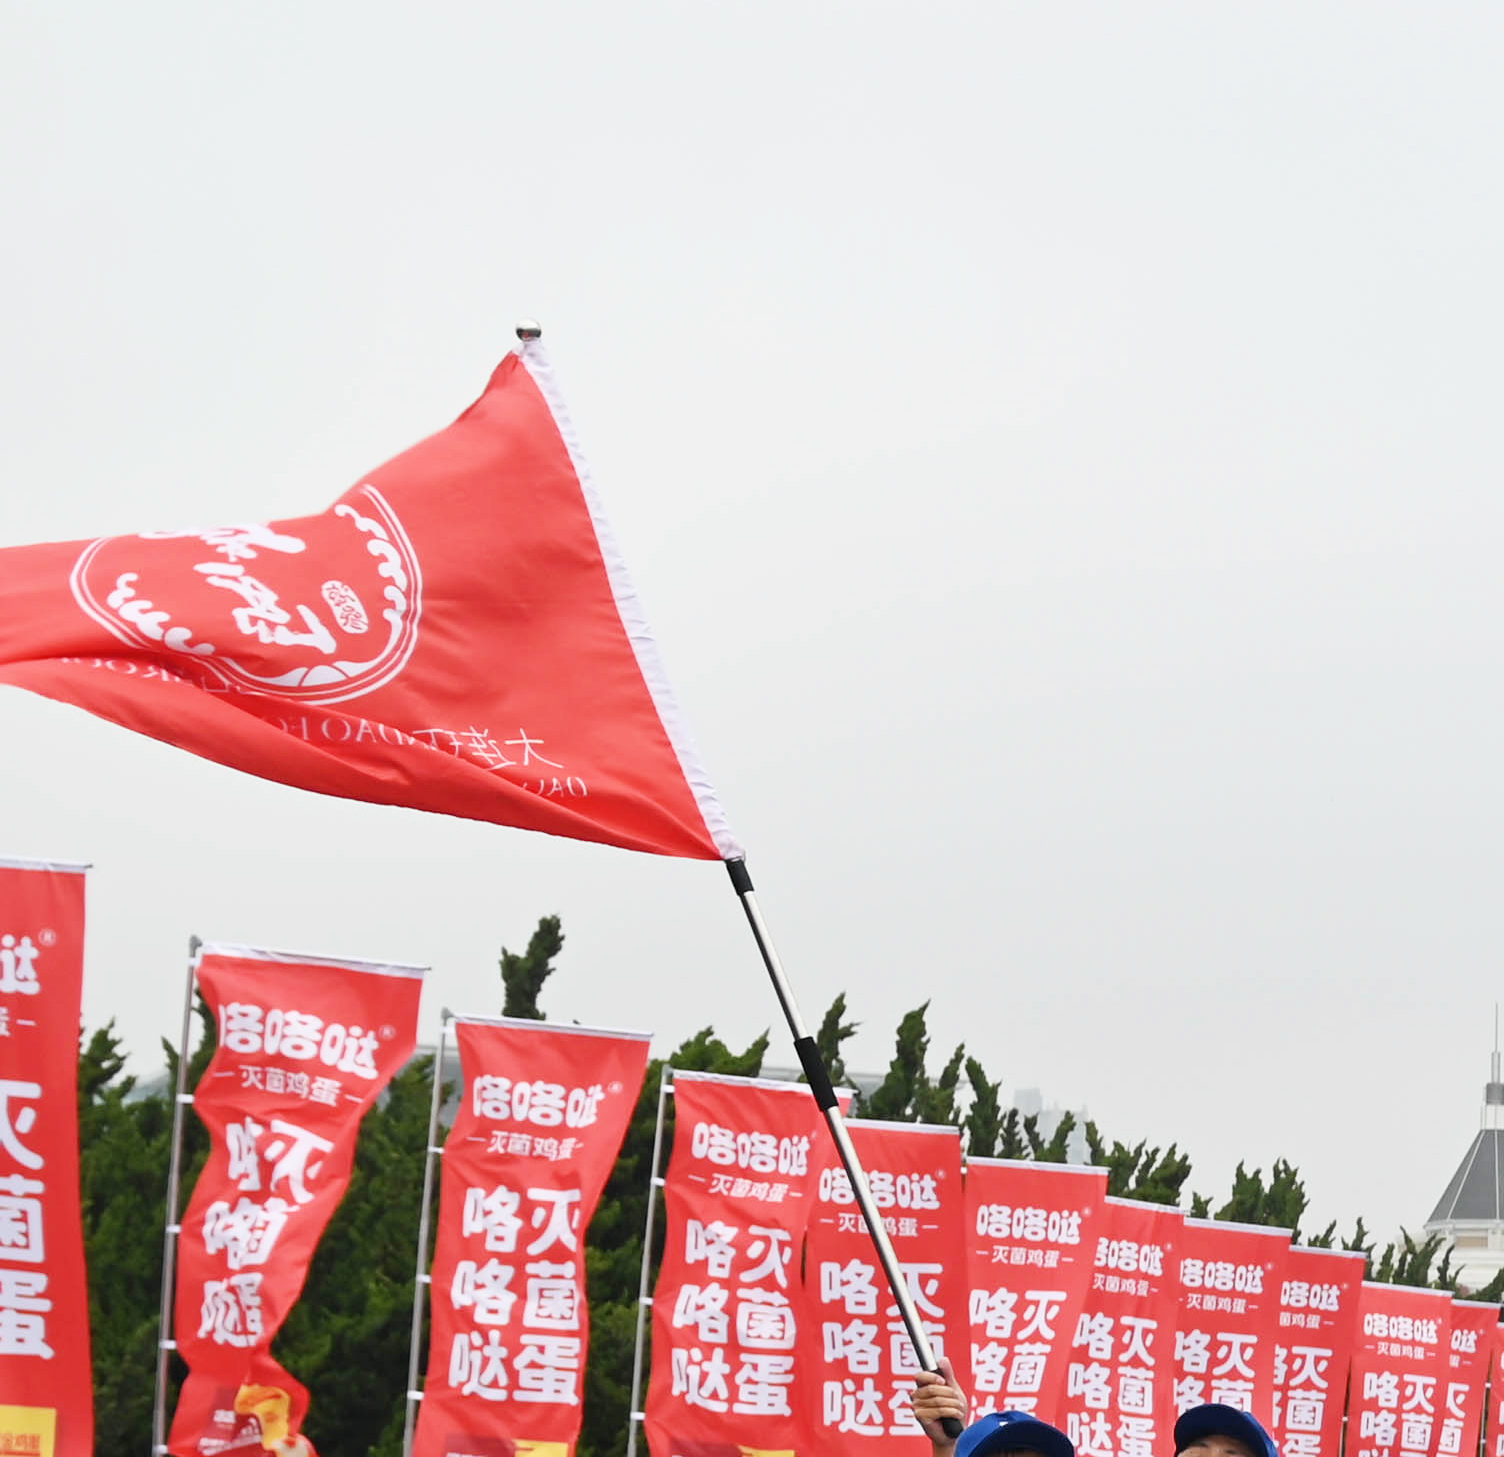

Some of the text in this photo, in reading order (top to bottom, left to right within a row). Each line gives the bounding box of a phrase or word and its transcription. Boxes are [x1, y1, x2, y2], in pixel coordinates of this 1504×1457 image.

[241, 1064, 342, 1107] 灭菌鸡蛋
[473, 1074, 605, 1128] 咯咯哒
[487, 1130, 575, 1162] 灭菌鸡蛋
[691, 1122, 811, 1177] 咯咯哒
[709, 1173, 789, 1204] 灭菌鸡蛋
[976, 1203, 1082, 1245] 咯咯哒
[992, 1245, 1060, 1268] 灭菌鸡蛋
[448, 1184, 523, 1401] 咯咯哒
[513, 1187, 582, 1406] 灭菌蛋
[1092, 1273, 1151, 1297] 灭菌鸡蛋
[1187, 1293, 1249, 1314] 灭菌鸡蛋
[671, 1219, 739, 1413] 咯咯哒
[733, 1225, 798, 1417] 灭菌蛋
[820, 1259, 884, 1437] 咯咯哒
